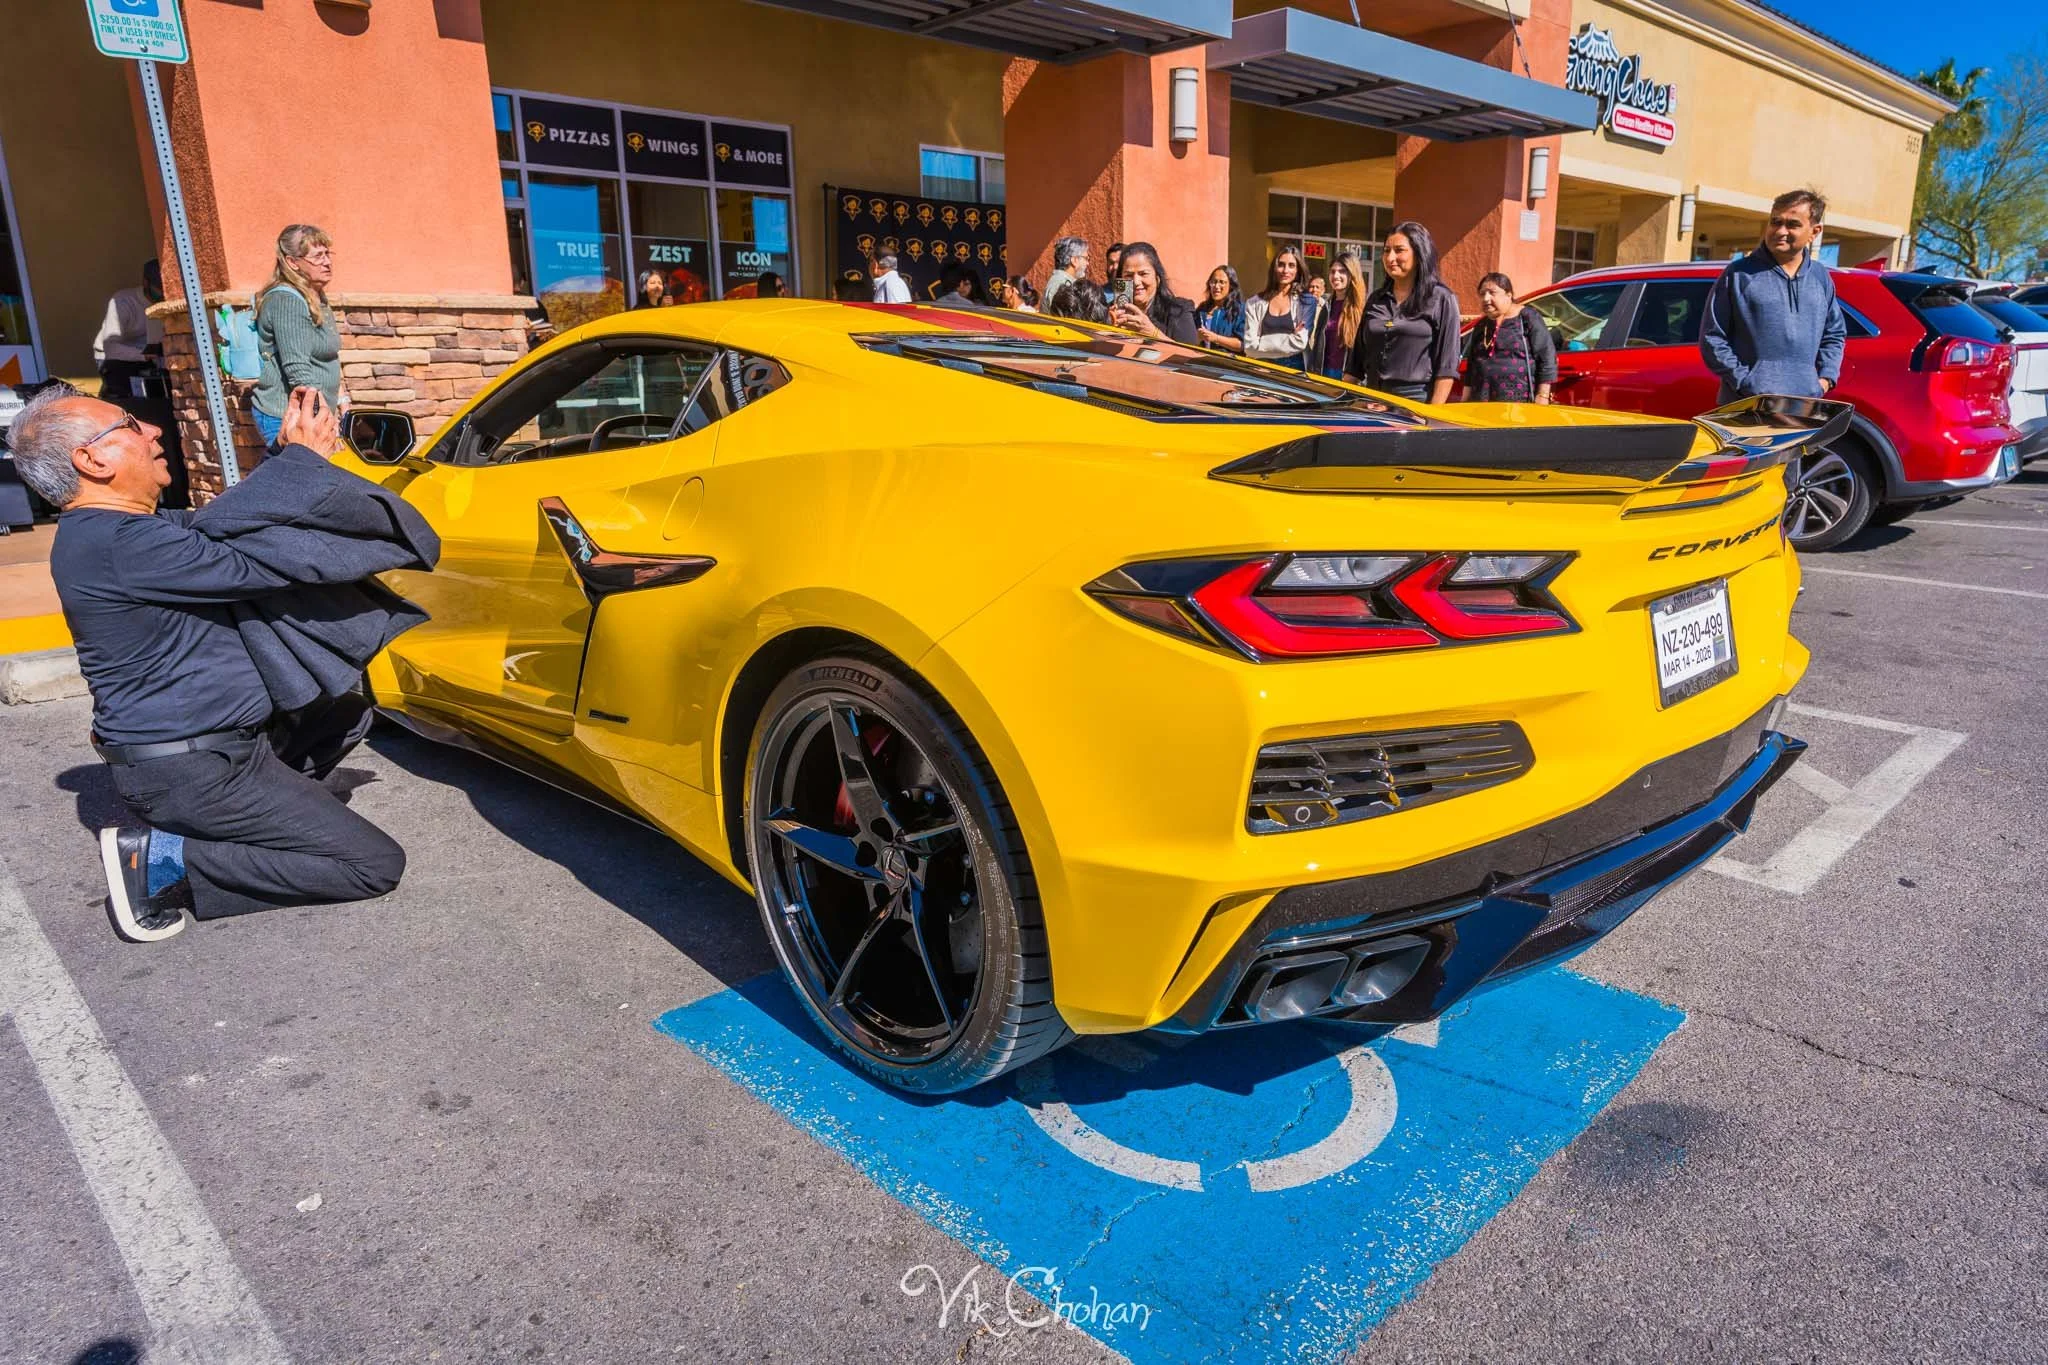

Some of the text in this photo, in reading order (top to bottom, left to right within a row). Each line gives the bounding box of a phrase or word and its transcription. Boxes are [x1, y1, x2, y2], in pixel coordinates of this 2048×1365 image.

[101, 24, 117, 34] FINE
[126, 27, 143, 37] USED
[144, 29, 154, 38] BY
[154, 30, 178, 42] OTHERS
[549, 127, 611, 146] PIZZAS
[647, 138, 699, 156] WINGS
[734, 149, 783, 165] & MORE
[556, 241, 600, 259] TRUE
[648, 244, 692, 264] ZEST
[736, 250, 772, 266] ICON
[1304, 242, 1325, 257] OPEN
[1662, 612, 1723, 657] NZ-230-499
[1663, 659, 1682, 677] MAR
[1681, 655, 1691, 670] 14
[1696, 645, 1712, 664] 2026
[813, 666, 878, 689] MICHELIN
